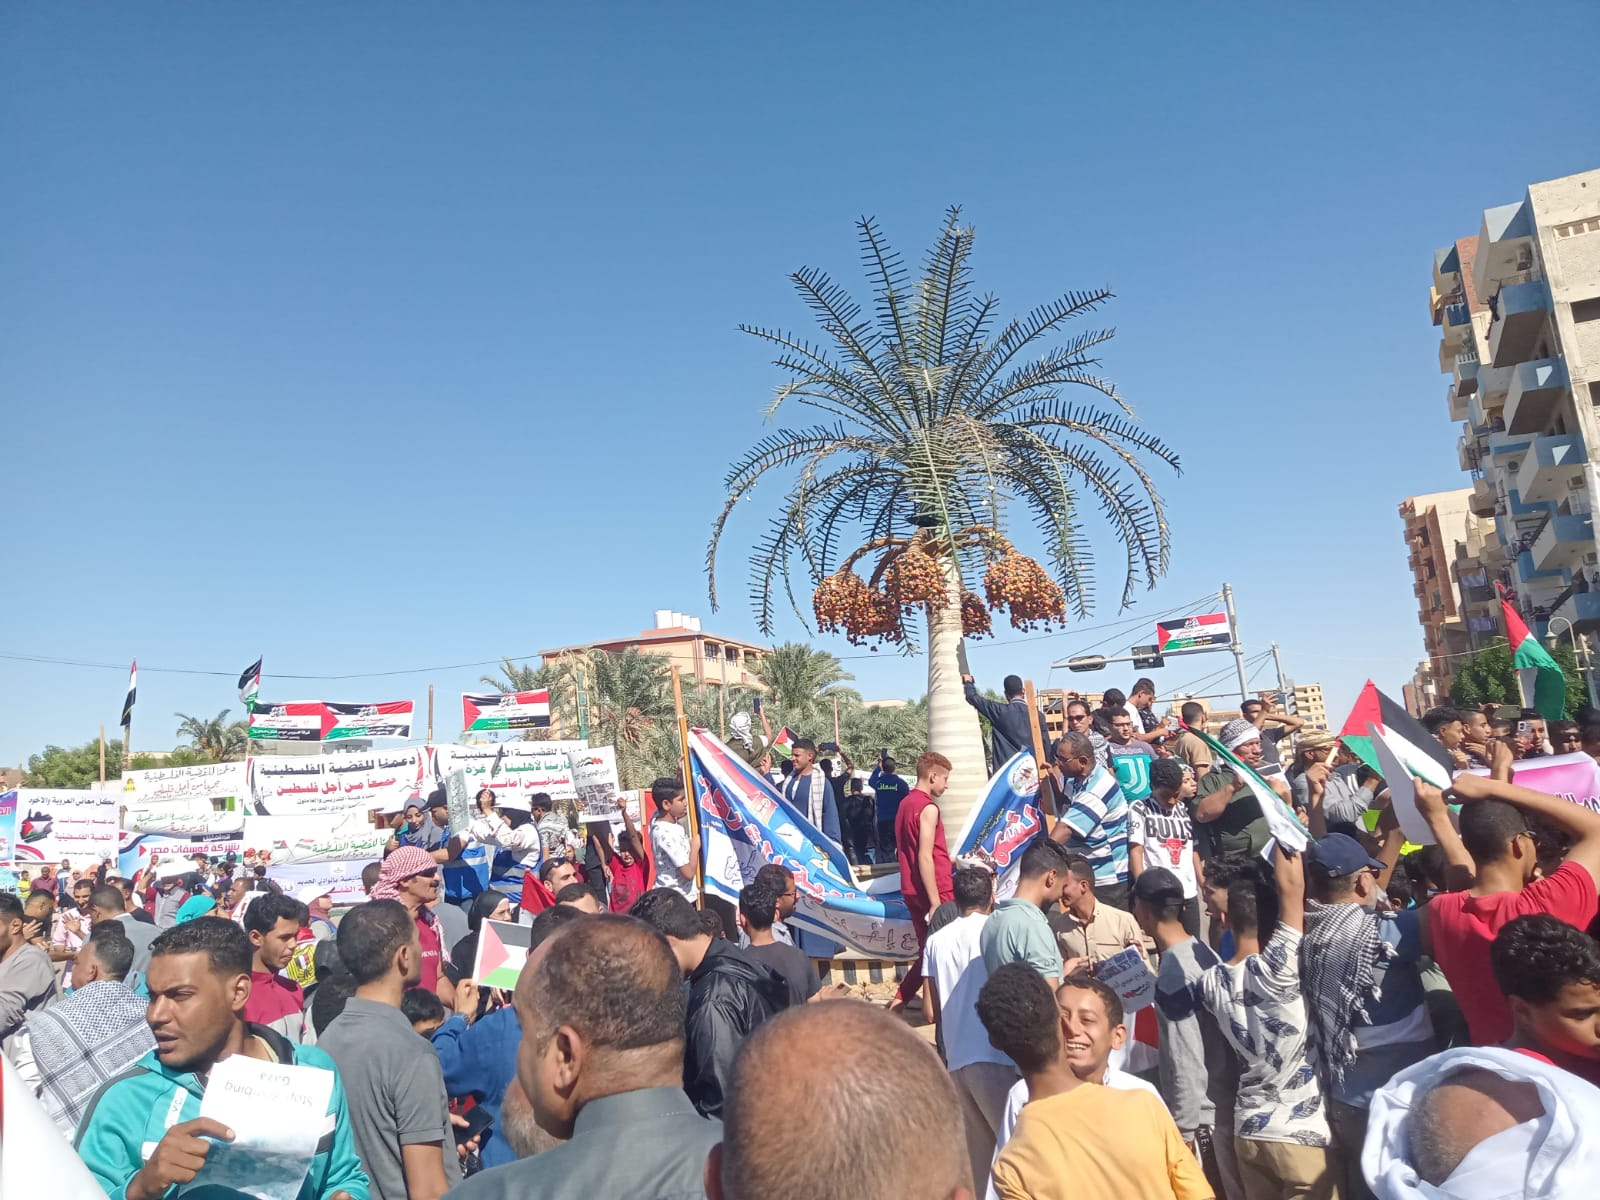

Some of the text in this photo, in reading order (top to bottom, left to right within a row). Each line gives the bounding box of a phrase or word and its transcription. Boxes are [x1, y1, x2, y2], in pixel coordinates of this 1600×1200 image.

[515, 748, 557, 760] للقضية
[260, 756, 416, 778] دعمنا للقضية الفلسطينية
[465, 764, 487, 776] غزة
[276, 783, 319, 797] فلسطين
[321, 778, 342, 795] أجل
[344, 783, 364, 794] من
[524, 776, 570, 790] فلسطين
[1145, 817, 1193, 841] BULLS
[54, 832, 90, 842] الفلسطينية
[259, 1072, 291, 1087] Gaza
[286, 1091, 313, 1108] Stop
